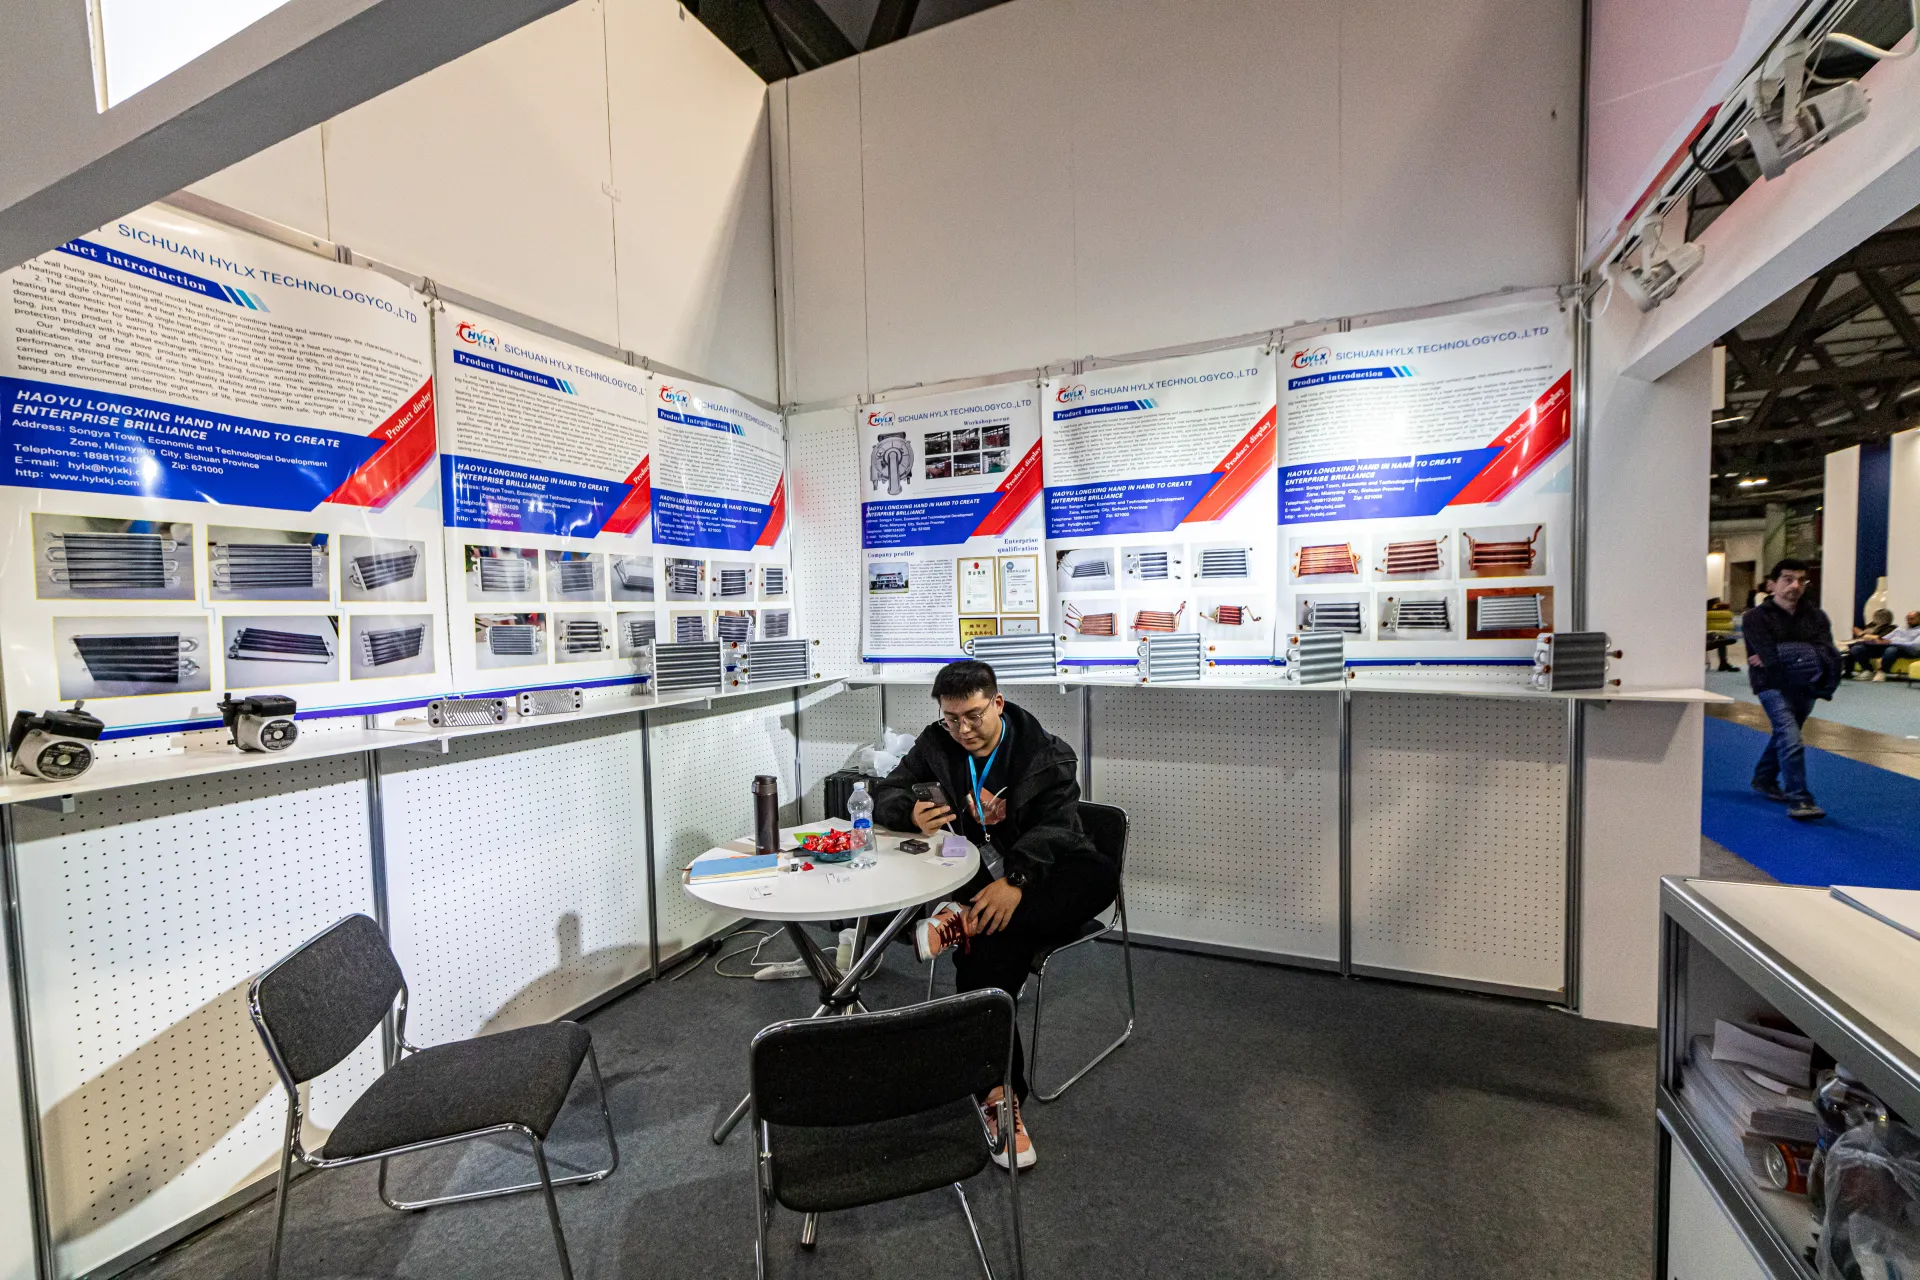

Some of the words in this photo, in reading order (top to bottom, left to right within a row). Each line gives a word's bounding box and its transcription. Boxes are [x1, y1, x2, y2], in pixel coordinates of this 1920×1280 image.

[29, 265, 62, 278] heating
[43, 260, 61, 268] wall
[63, 264, 86, 276] hung
[88, 272, 102, 280] gas
[104, 274, 126, 287] boiler
[106, 251, 207, 292] introduction
[118, 223, 205, 263] SICHUAN
[209, 254, 256, 279] HYLX
[260, 269, 417, 324] TECHNOLOGYCO.,LTD
[12, 278, 47, 293] heating
[50, 288, 66, 296] and
[68, 291, 106, 306] domestic
[46, 277, 62, 286] The
[65, 283, 90, 293] single
[92, 289, 123, 302] channel
[14, 307, 61, 322] protection
[63, 317, 96, 330] product
[15, 326, 71, 342] qualification
[75, 338, 91, 346] rate
[467, 330, 496, 346] HYLX
[1300, 352, 1327, 365] HYLX
[1335, 348, 1384, 361] SICHUAN
[1385, 345, 1415, 357] HYLX
[1416, 325, 1549, 355] TECHNOLOGYCO.,LTD
[16, 336, 75, 352] performance,
[78, 347, 104, 358] strong
[106, 353, 139, 365] pressure
[504, 343, 548, 364] SICHUAN
[549, 357, 573, 373] HYLX
[17, 354, 73, 369] temperature
[76, 364, 128, 379] environment
[18, 363, 47, 375] saving
[49, 369, 66, 377] and
[68, 372, 128, 387] environmental
[129, 383, 167, 395] protection
[459, 353, 495, 371] Product
[498, 364, 549, 385] introduction
[1292, 375, 1325, 388] Product
[1328, 369, 1383, 381] introduction
[1063, 389, 1083, 400] HYLX
[1089, 385, 1129, 397] SICHUAN
[1130, 382, 1155, 392] HYLX
[1155, 367, 1259, 389] TECHNOLOGYCO.,LTD
[665, 392, 687, 403] HYLX
[12, 404, 120, 427] ENTERPRISE
[123, 418, 208, 440] BRILLIANCE
[17, 390, 82, 408] HAOYU
[86, 400, 171, 422] LONGXING
[174, 414, 214, 430] HAND
[217, 422, 231, 433] IN
[234, 426, 271, 439] HAND
[274, 432, 291, 442] TO
[294, 435, 341, 448] CREATE
[385, 411, 414, 439] Product
[412, 390, 432, 415] display
[873, 416, 893, 424] HYLX
[898, 412, 929, 423] SICHUAN
[929, 410, 949, 419] HYLX
[950, 399, 1032, 416] TECHNOLOGYCO.,LTD
[963, 417, 992, 427] Workshop
[1056, 409, 1082, 420] Product
[1083, 403, 1129, 415] introduction
[12, 418, 66, 432] Address:
[69, 425, 111, 438] Songya
[148, 435, 195, 450] Economic
[196, 444, 213, 453] and
[216, 446, 274, 461] Technological
[275, 454, 328, 468] Development
[70, 437, 102, 449] Zone,
[104, 441, 156, 457] Mianyang
[160, 448, 182, 459] City,
[184, 451, 221, 464] Sichuan
[222, 458, 260, 470] Province
[1224, 443, 1250, 470] Product
[1249, 420, 1271, 444] display
[13, 443, 80, 458] Telephone:
[171, 461, 189, 471] Zip:
[191, 464, 224, 475] 621000
[14, 456, 59, 468] E-mail:
[1004, 466, 1026, 491] Product
[1024, 445, 1042, 469] display
[1286, 469, 1314, 478] HAOYU
[1313, 465, 1356, 476] LONGXING
[1356, 462, 1380, 472] HAND
[1380, 461, 1391, 470] IN
[1416, 459, 1428, 468] TO
[1429, 456, 1463, 467] CREATE
[15, 468, 44, 479] http:
[50, 472, 140, 487] www.hylxkj.com
[455, 471, 504, 485] ENTERPRISE
[505, 478, 546, 491] BRILLIANCE
[457, 463, 488, 474] HAOYU
[489, 468, 528, 480] LONGXING
[530, 473, 549, 483] HAND
[550, 476, 558, 484] IN
[559, 477, 577, 487] HAND
[578, 481, 587, 489] TO
[587, 482, 610, 493] CREATE
[1052, 489, 1074, 497] HAOYU
[1074, 486, 1108, 496] LONGXING
[1108, 485, 1127, 493] HAND
[1135, 483, 1155, 491] HAND
[1156, 481, 1166, 489] TO
[1167, 480, 1193, 488] CREATE
[1285, 474, 1330, 486] ENTERPRISE
[1330, 471, 1376, 482] BRILLIANCE
[686, 505, 717, 515] BRILLIANCE
[884, 503, 913, 511] LONGXING
[959, 498, 980, 506] CREATE
[1051, 495, 1088, 505] ENTERPRISE
[1088, 492, 1123, 502] BRILLIANCE
[895, 508, 926, 516] BRILLIANCE
[997, 545, 1039, 554] qualification
[1004, 536, 1039, 546] Enterprise
[867, 551, 893, 560] Company
[893, 550, 915, 558] profile
